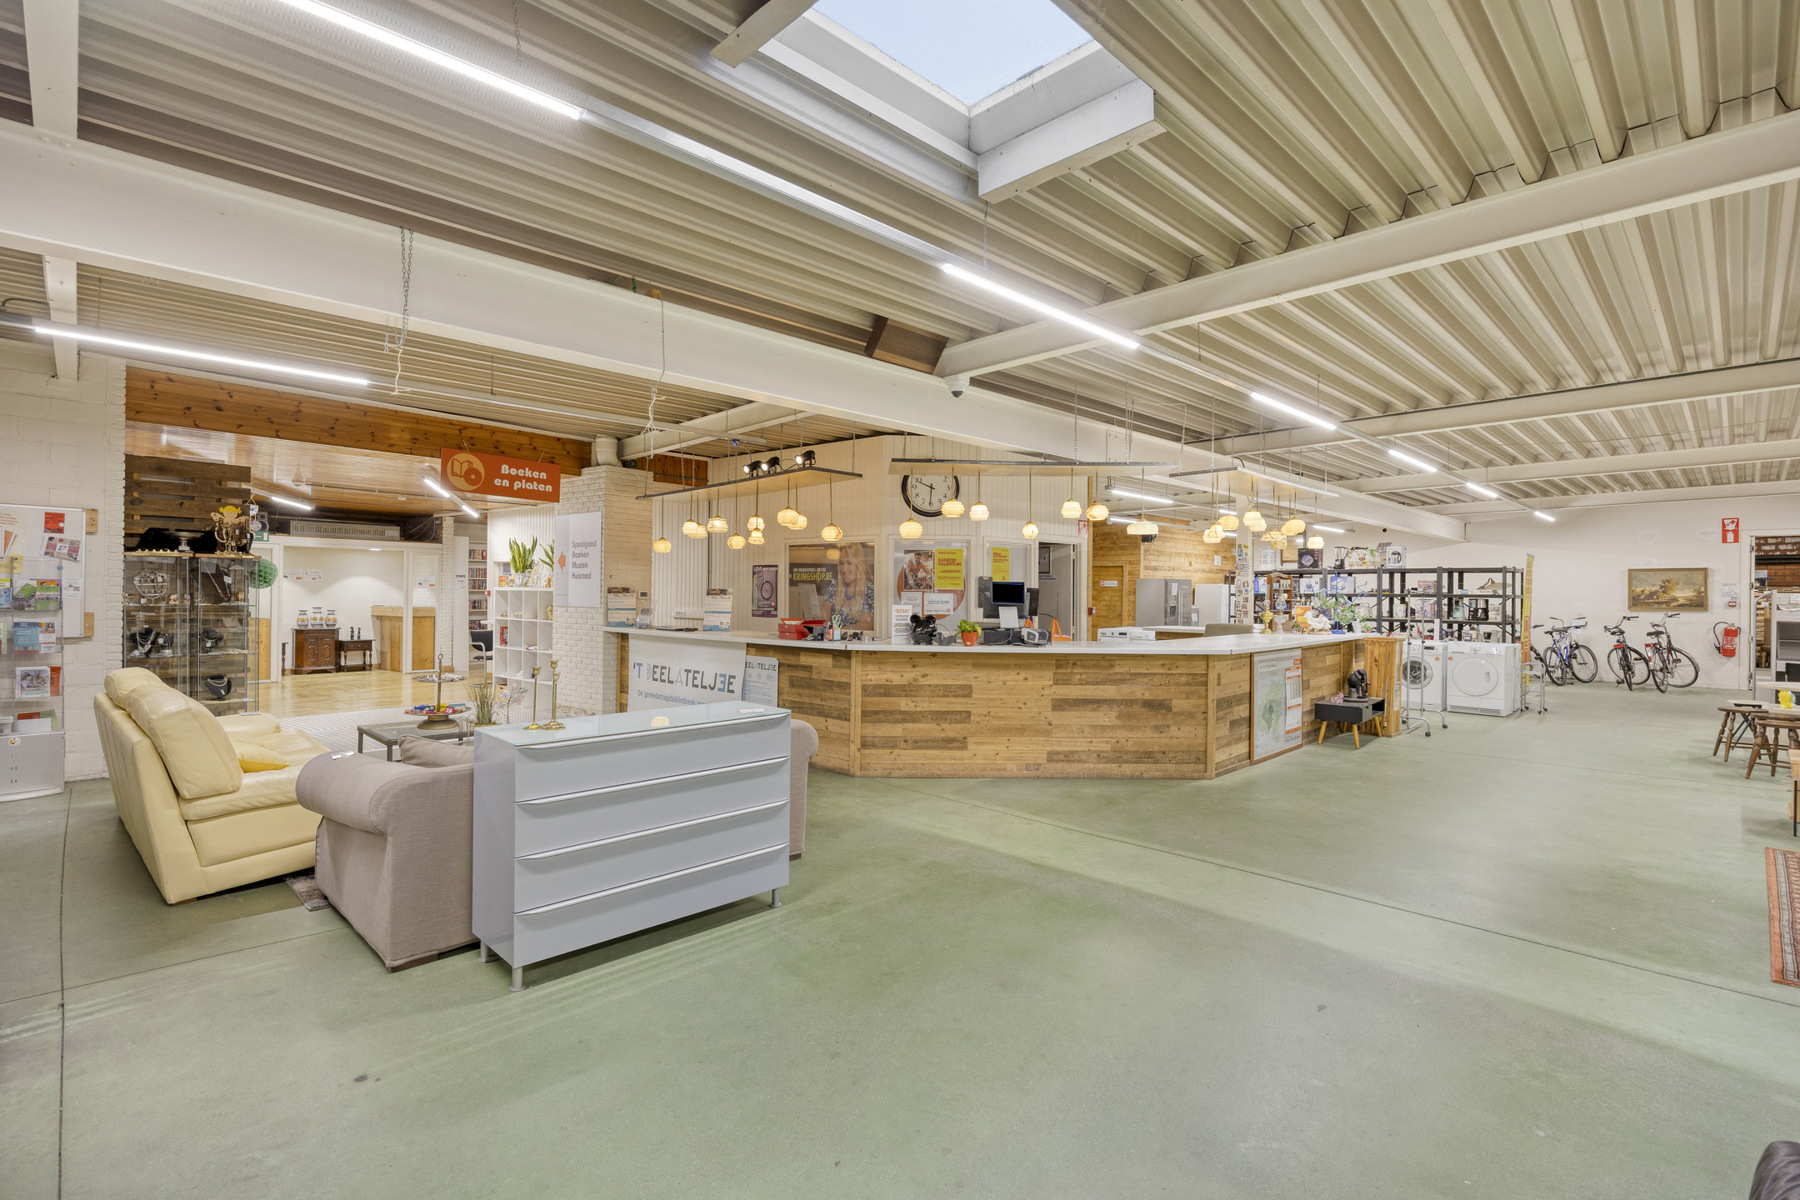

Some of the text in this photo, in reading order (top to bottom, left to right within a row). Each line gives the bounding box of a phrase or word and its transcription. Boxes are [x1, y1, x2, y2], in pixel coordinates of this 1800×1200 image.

[501, 464, 547, 480] Boeken
[494, 478, 552, 492] en platen
